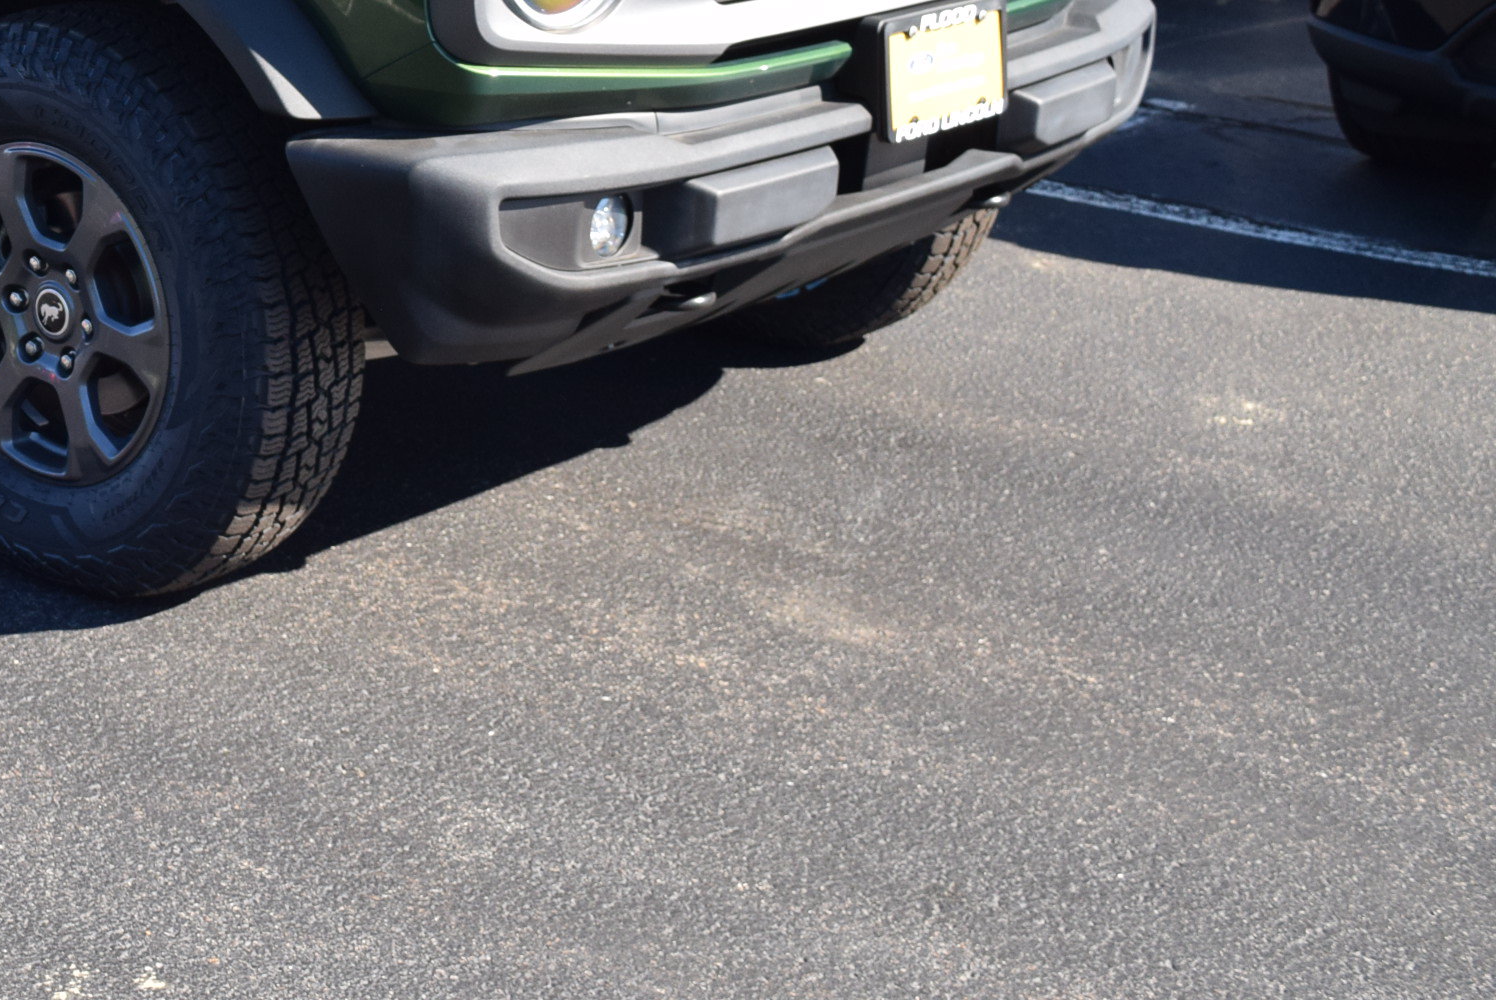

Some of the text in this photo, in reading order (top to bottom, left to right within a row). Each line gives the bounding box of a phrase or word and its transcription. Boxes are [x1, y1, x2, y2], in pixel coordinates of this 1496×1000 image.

[920, 4, 977, 32] FLOOD
[895, 98, 1004, 143] FORD LINCOLN
